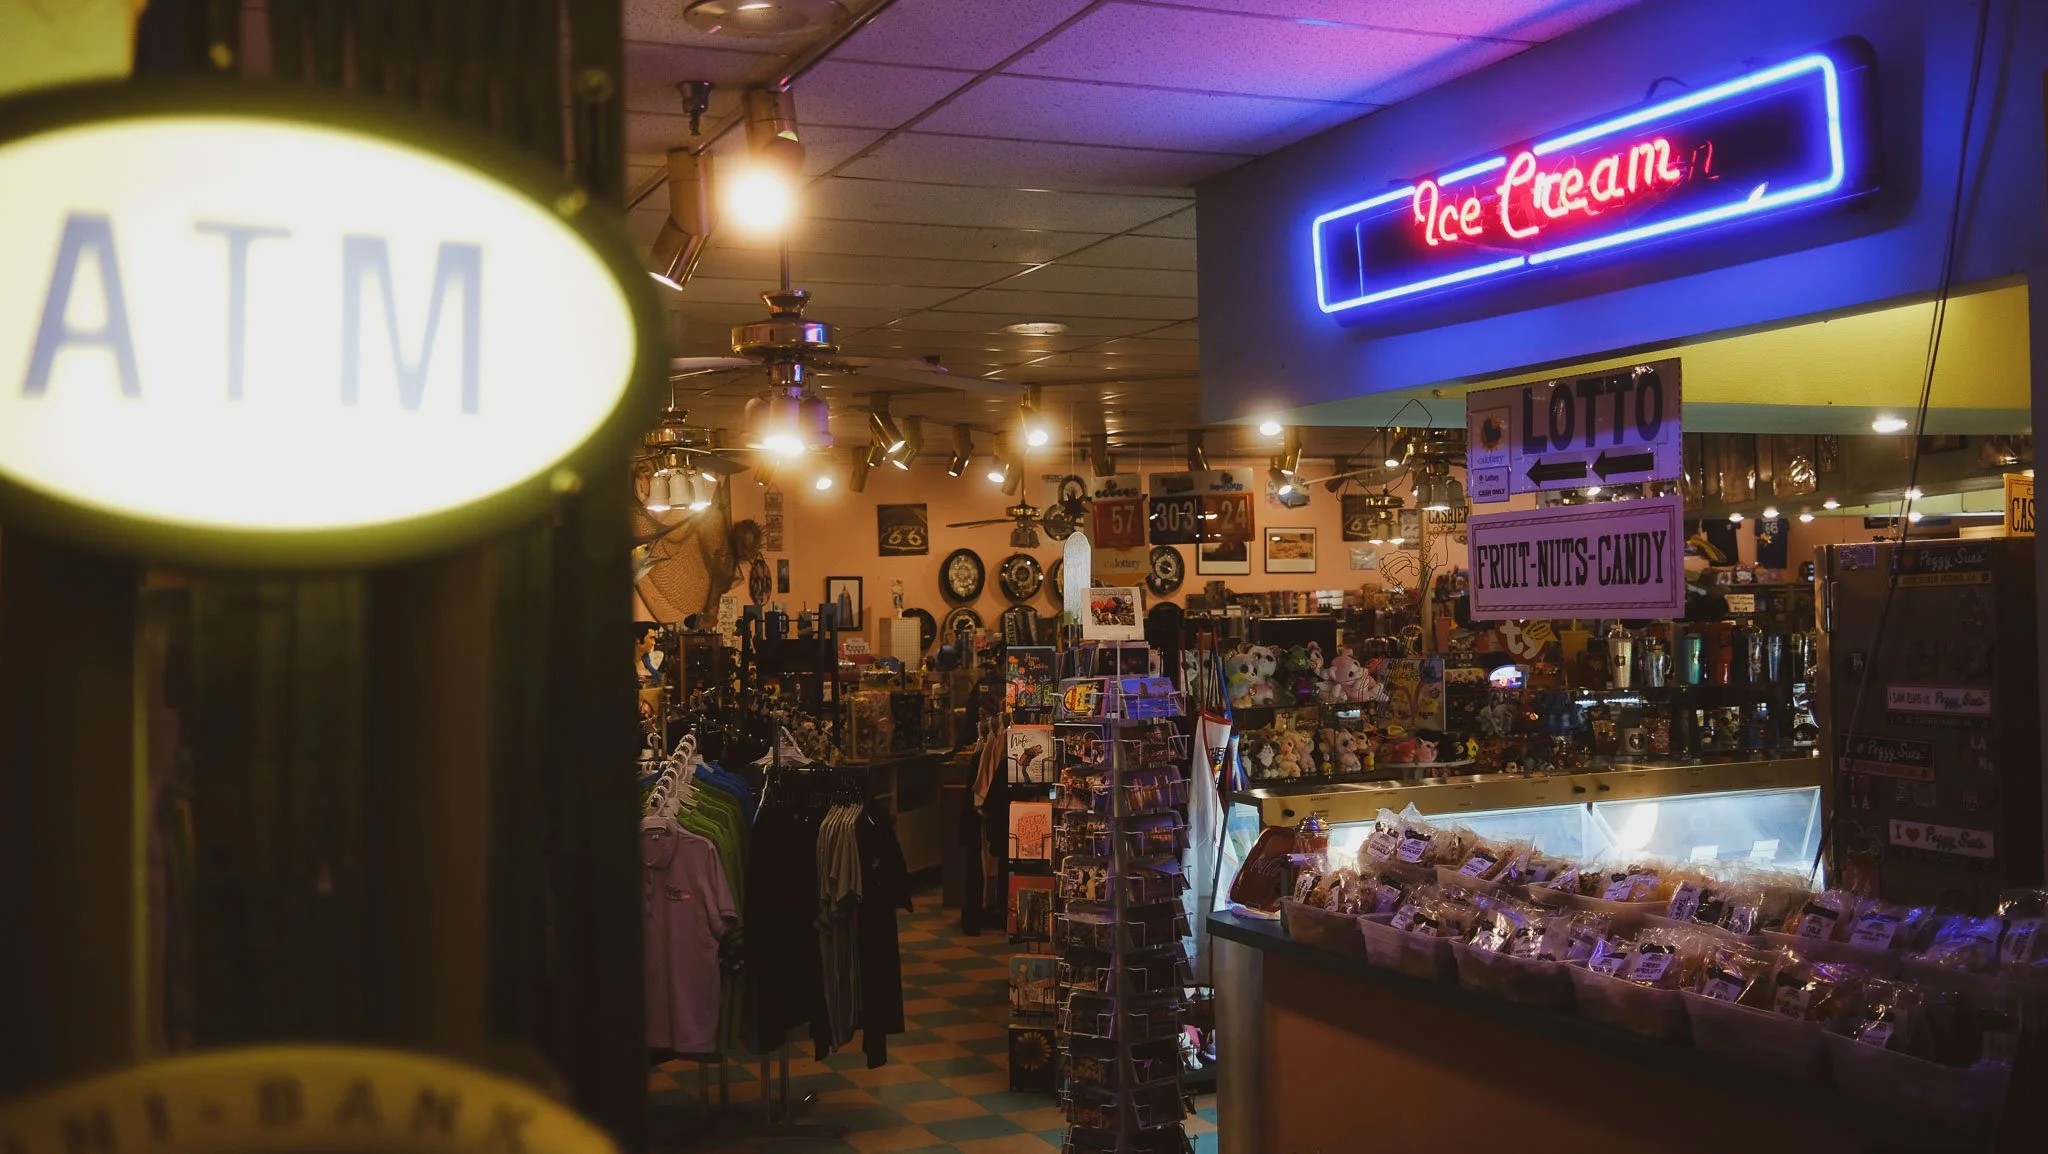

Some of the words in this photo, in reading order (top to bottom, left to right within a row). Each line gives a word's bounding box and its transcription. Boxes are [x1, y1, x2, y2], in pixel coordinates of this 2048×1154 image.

[1413, 180, 1483, 246] Ice
[1497, 137, 1680, 239] Cream
[21, 211, 483, 415] ATM
[1522, 367, 1664, 455] LOTTO
[1111, 504, 1136, 535] 57
[1156, 500, 1196, 532] 303
[1221, 499, 1248, 529] 24
[888, 529, 922, 546] 66
[1477, 530, 1667, 589] FRUIT-NUTS-CANDY
[1919, 550, 1954, 571] Peggy
[1500, 620, 1546, 660] ty
[1907, 692, 1922, 704] ELVIS
[1935, 690, 1961, 710] Peggy
[1868, 739, 1898, 762] Peggy
[1895, 824, 1902, 839] I
[1926, 826, 1958, 851] Peggy
